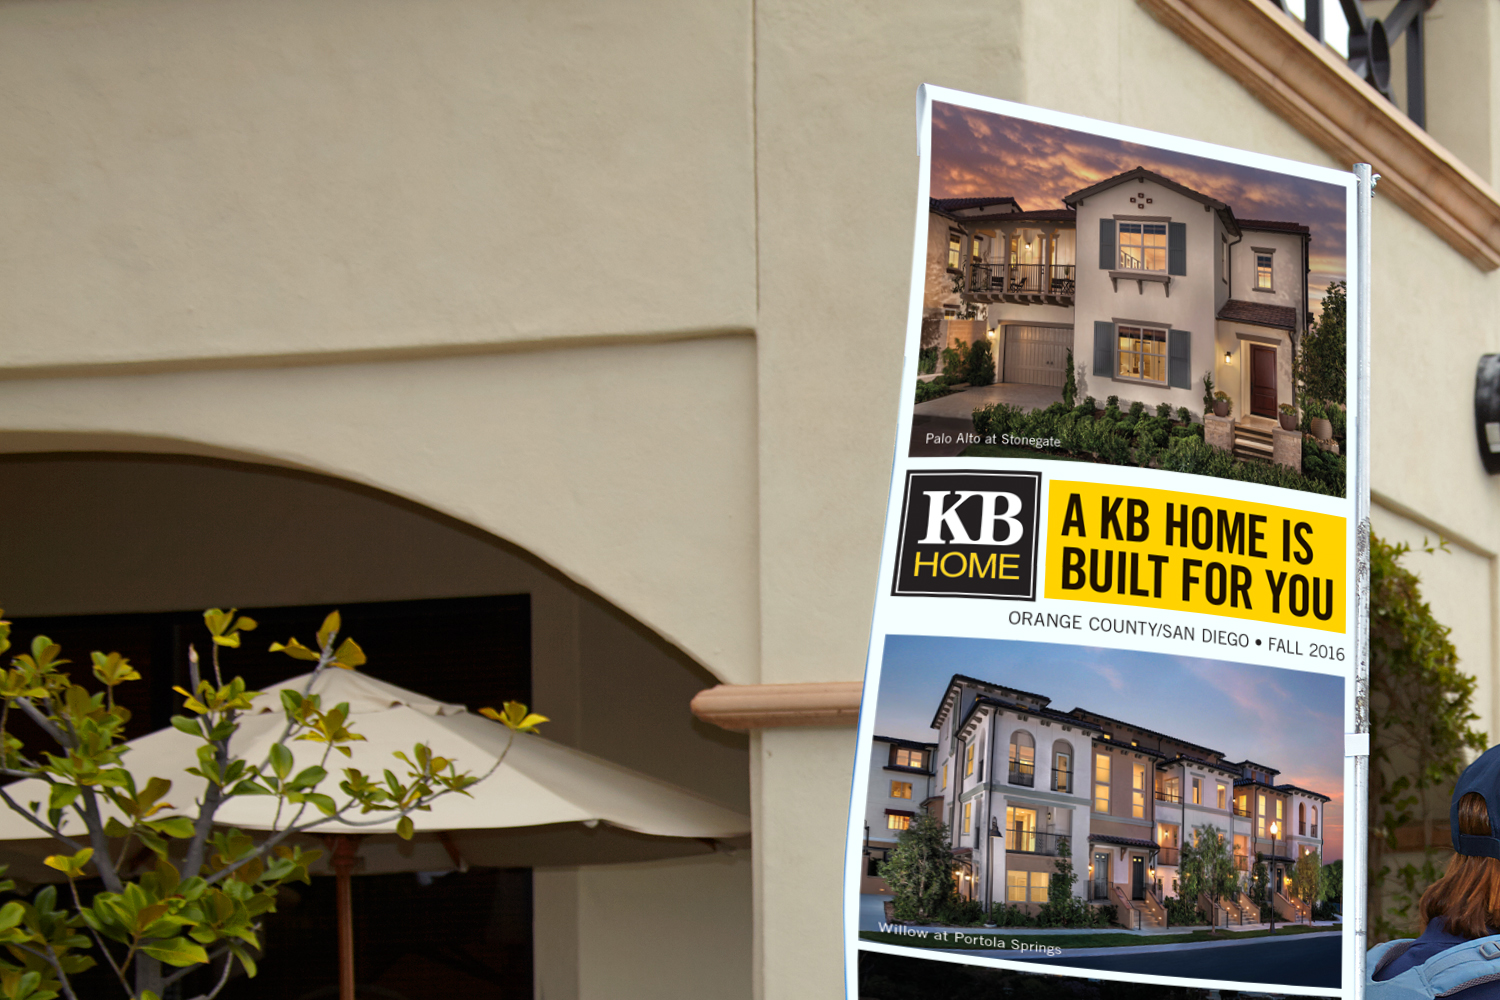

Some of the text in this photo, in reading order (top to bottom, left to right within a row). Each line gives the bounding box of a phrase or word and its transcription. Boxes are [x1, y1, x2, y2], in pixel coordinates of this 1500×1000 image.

[925, 432, 1061, 449] Palo Alto at Stonegate
[917, 490, 1024, 546] KB
[1061, 493, 1314, 565] A KB HOME IS
[913, 551, 1021, 580] HOME
[1061, 546, 1334, 621] BUILT FOR YOU
[1008, 610, 1346, 661] ORANGE COUNTY/SAN DIEGO FALL 2016
[878, 921, 1062, 957] Willow at Portola Springs
